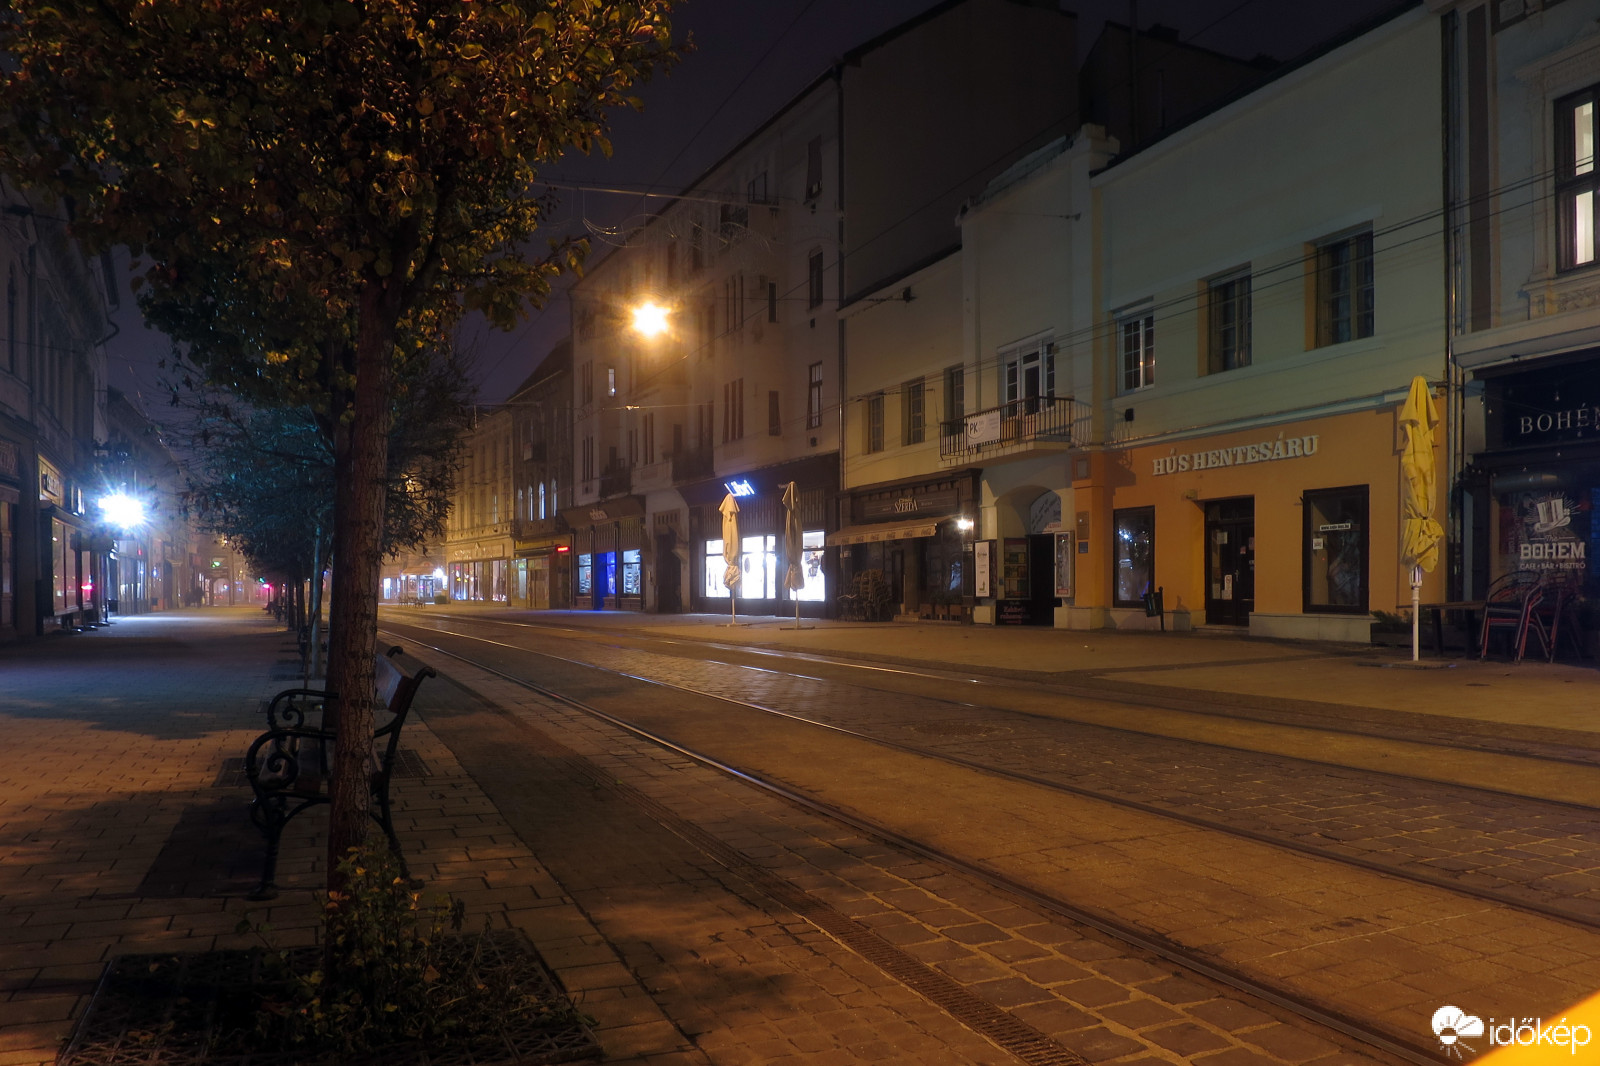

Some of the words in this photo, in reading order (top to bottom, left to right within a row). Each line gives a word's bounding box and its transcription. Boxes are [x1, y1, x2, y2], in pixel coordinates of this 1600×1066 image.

[969, 422, 978, 435] PK
[1152, 447, 1191, 476] HÚS
[1191, 431, 1320, 471] HENTESÁRU
[723, 479, 755, 497] Libri
[1519, 541, 1586, 560] BOHEM
[1541, 561, 1554, 570] BÁR
[1559, 559, 1586, 569] BISZTRÓ
